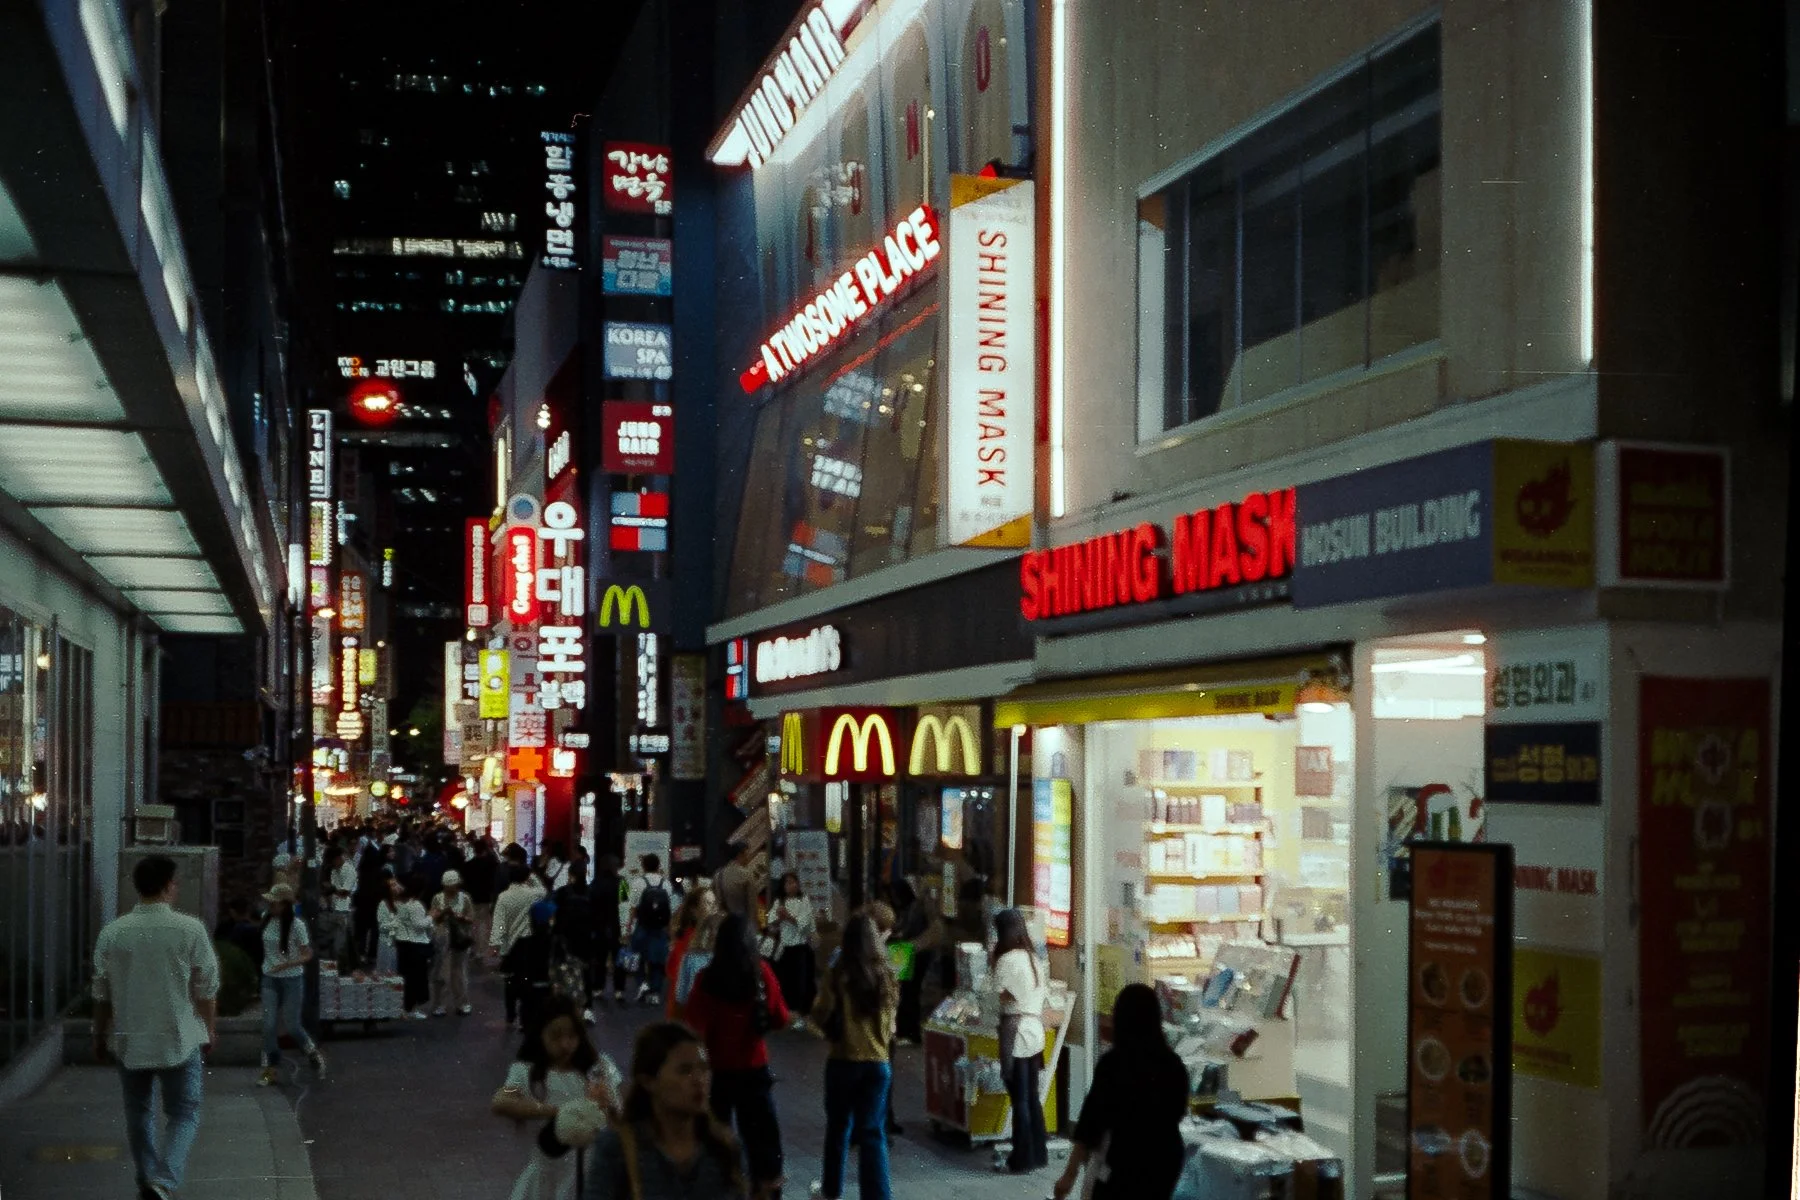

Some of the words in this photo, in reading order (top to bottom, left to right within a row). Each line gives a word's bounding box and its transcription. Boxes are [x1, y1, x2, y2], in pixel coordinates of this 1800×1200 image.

[774, 7, 846, 110] HAIR
[544, 145, 576, 255] 함흥냉면
[854, 206, 941, 305] PLACE
[976, 228, 1008, 373] SHINING
[608, 328, 669, 347] KOREA
[636, 348, 669, 365] SPA
[760, 343, 785, 383] A
[769, 271, 867, 370] TWOSOME
[976, 388, 1008, 488] MASK
[1020, 521, 1160, 621] SHINING
[1172, 485, 1297, 595] MASK
[1374, 489, 1481, 555] BUILDING
[536, 502, 586, 673] 우대포
